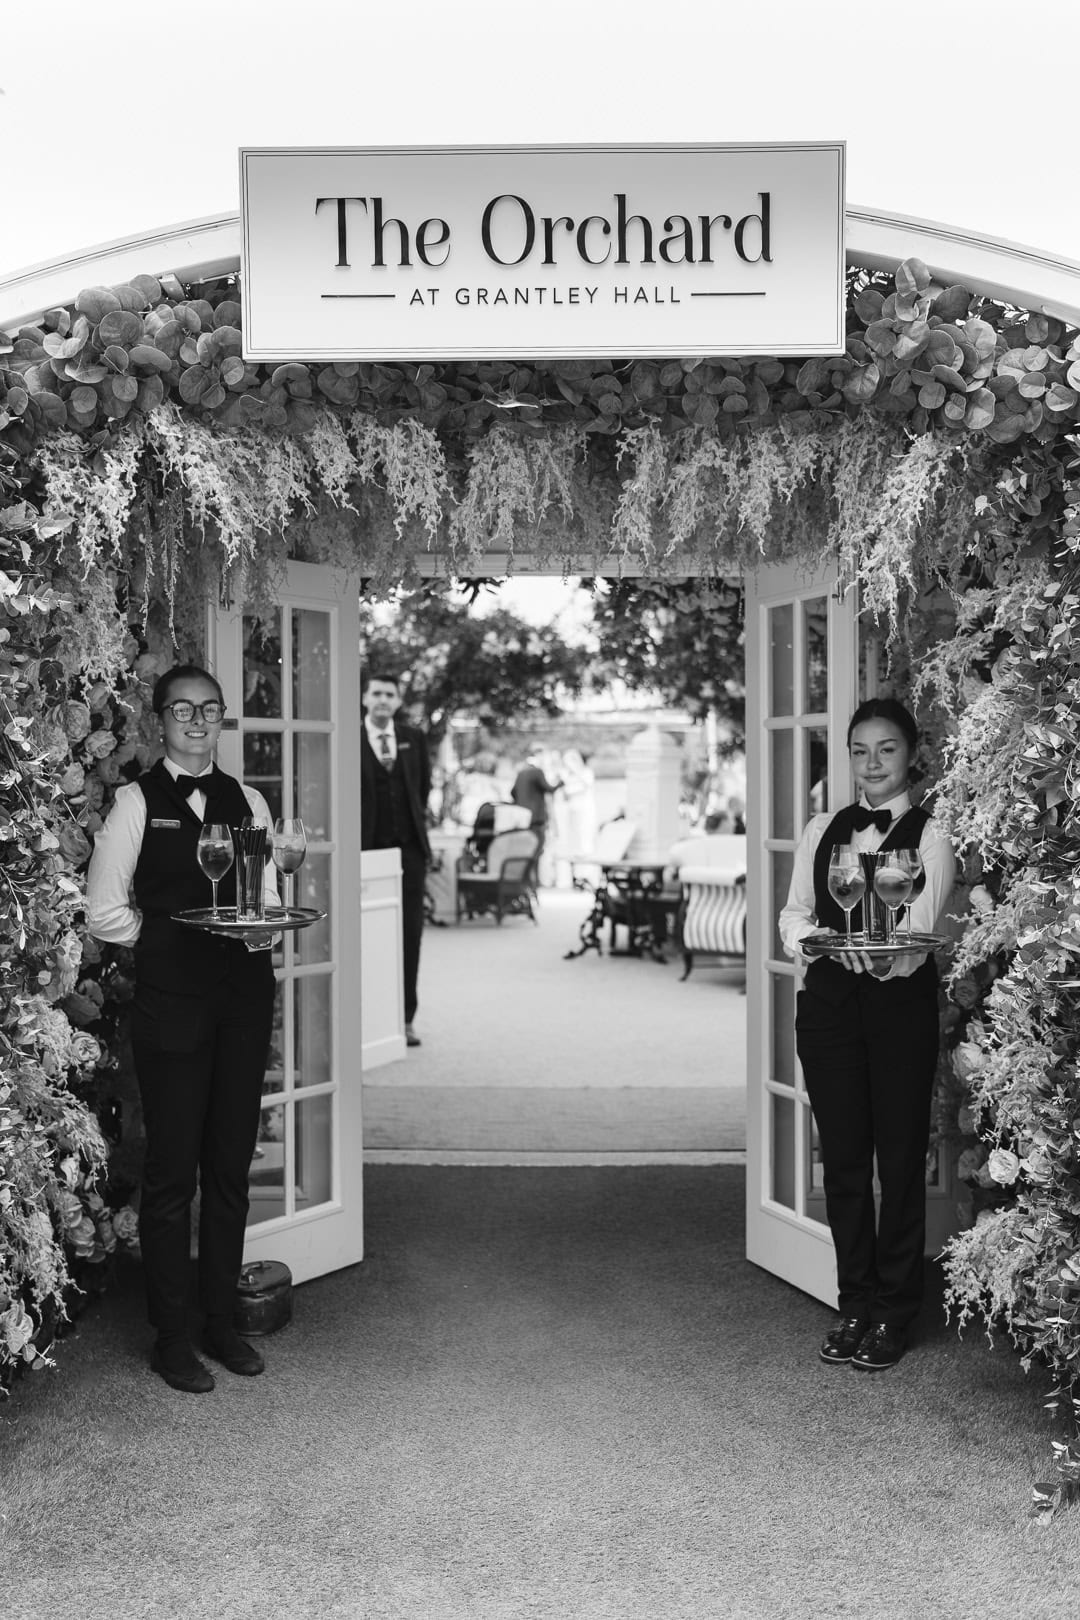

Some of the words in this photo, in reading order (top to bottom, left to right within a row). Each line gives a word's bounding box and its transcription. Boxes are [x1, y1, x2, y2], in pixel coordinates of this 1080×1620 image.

[315, 197, 452, 268] The
[481, 191, 774, 266] Orchard
[409, 288, 440, 305] AT
[455, 287, 599, 305] GRANTLEY
[614, 286, 681, 304] HALL
